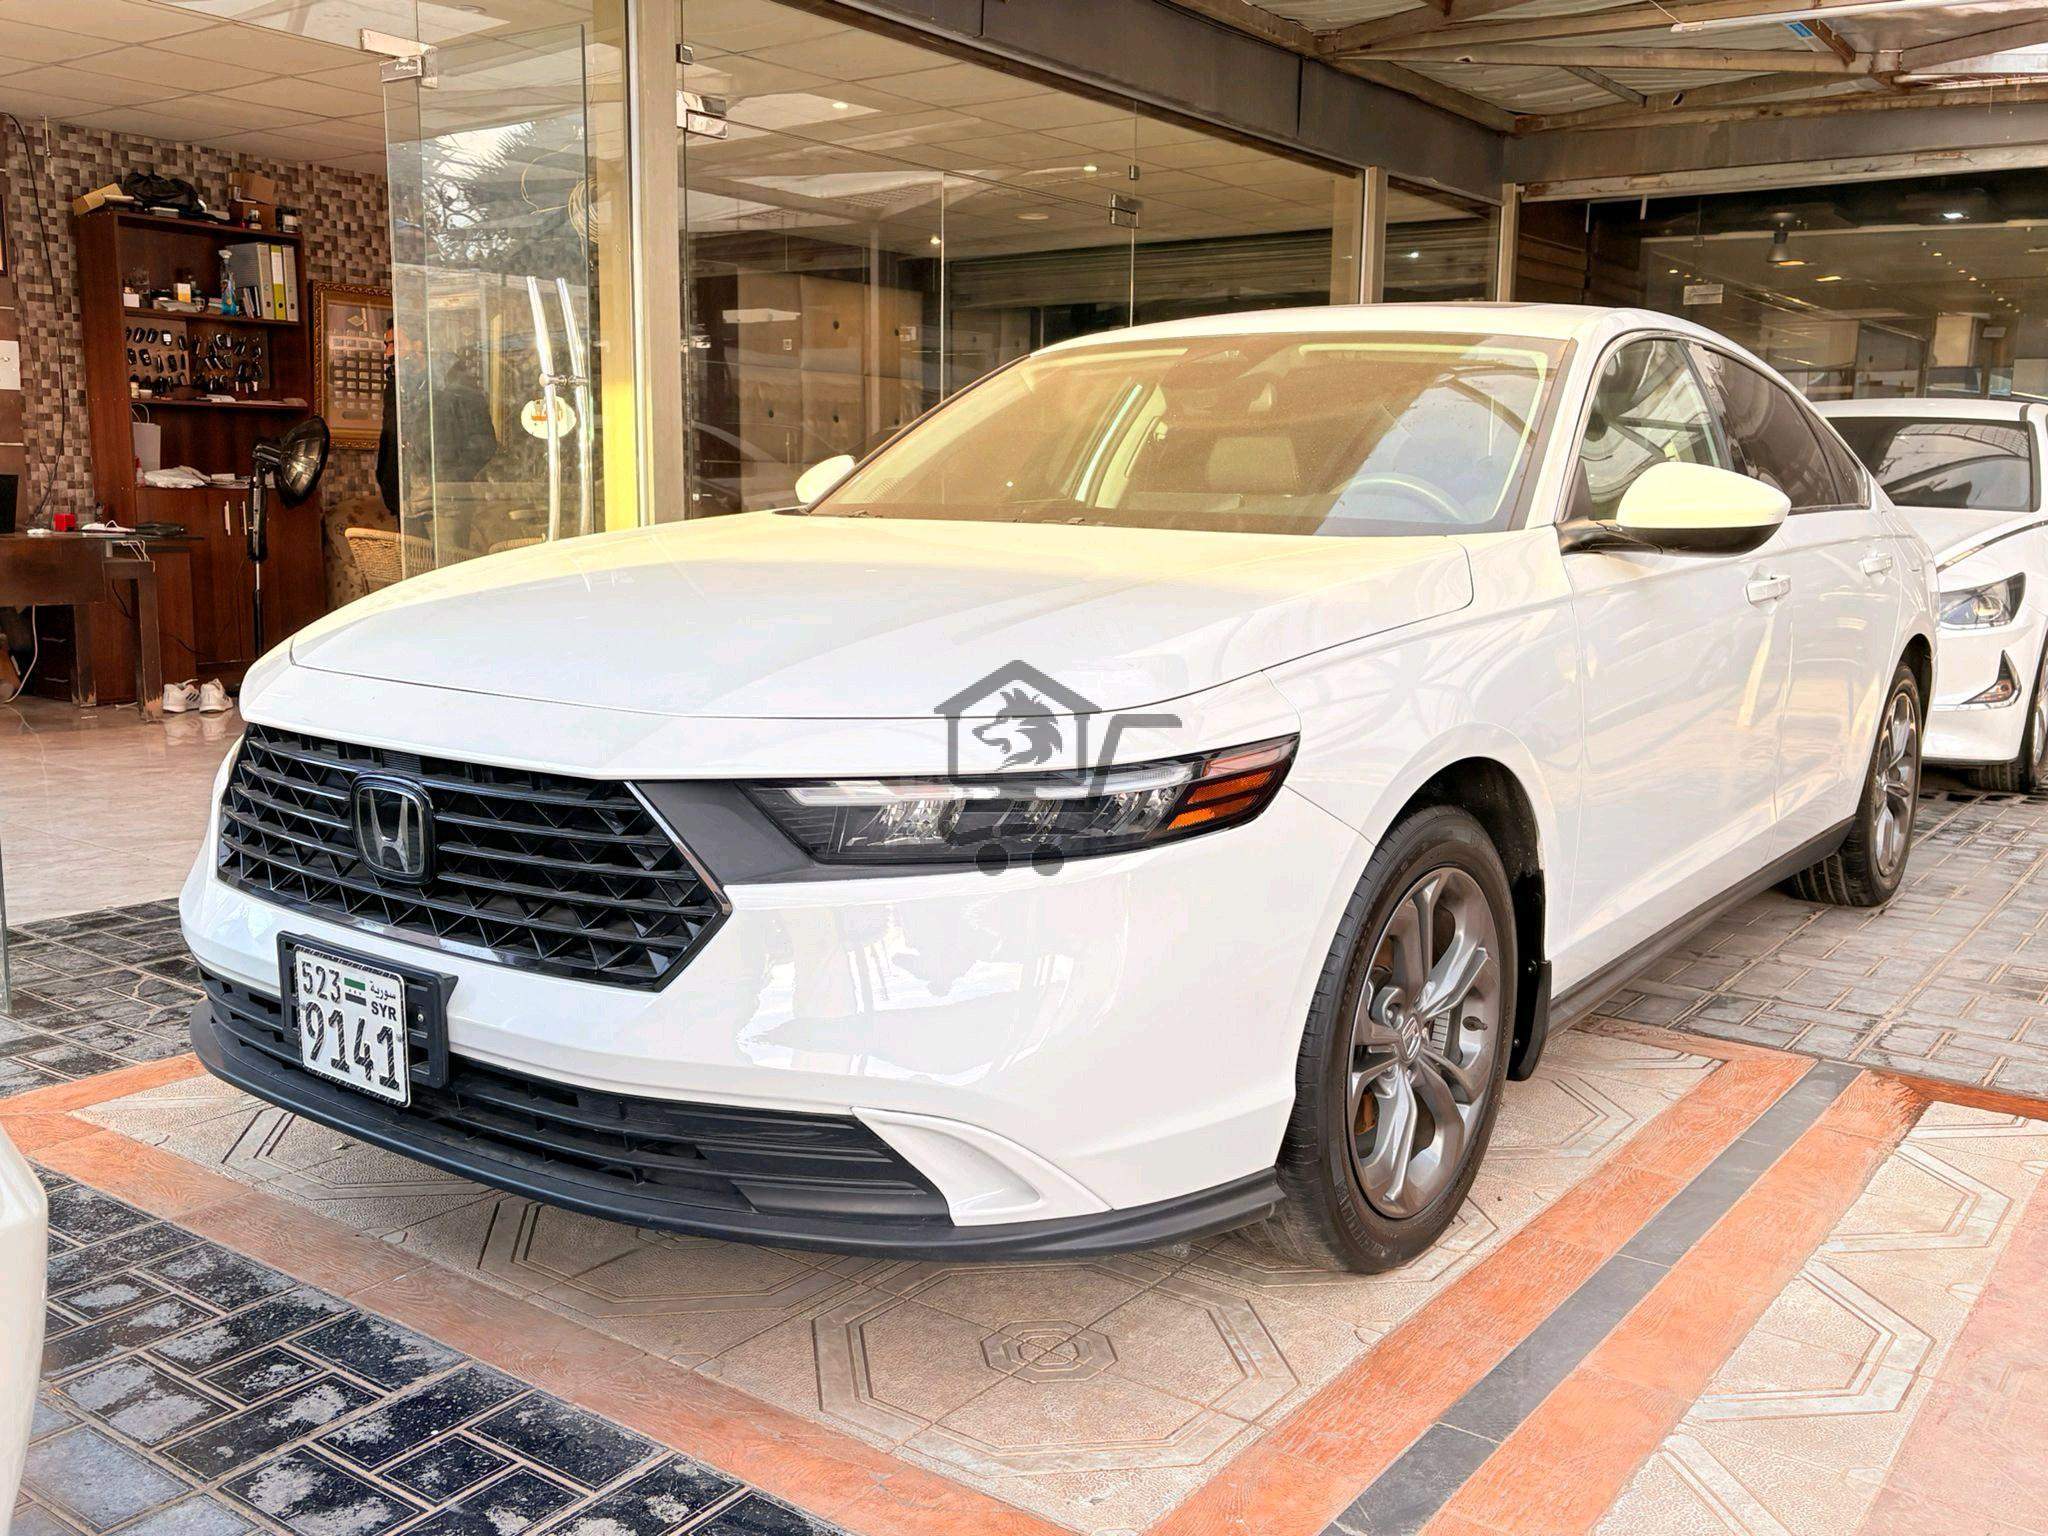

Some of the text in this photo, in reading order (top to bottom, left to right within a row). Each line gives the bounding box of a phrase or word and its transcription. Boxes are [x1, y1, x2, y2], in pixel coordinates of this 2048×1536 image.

[302, 960, 341, 1003] 523
[369, 980, 396, 1001] سورية
[370, 1001, 397, 1021] SYR
[305, 1002, 400, 1091] 9141
